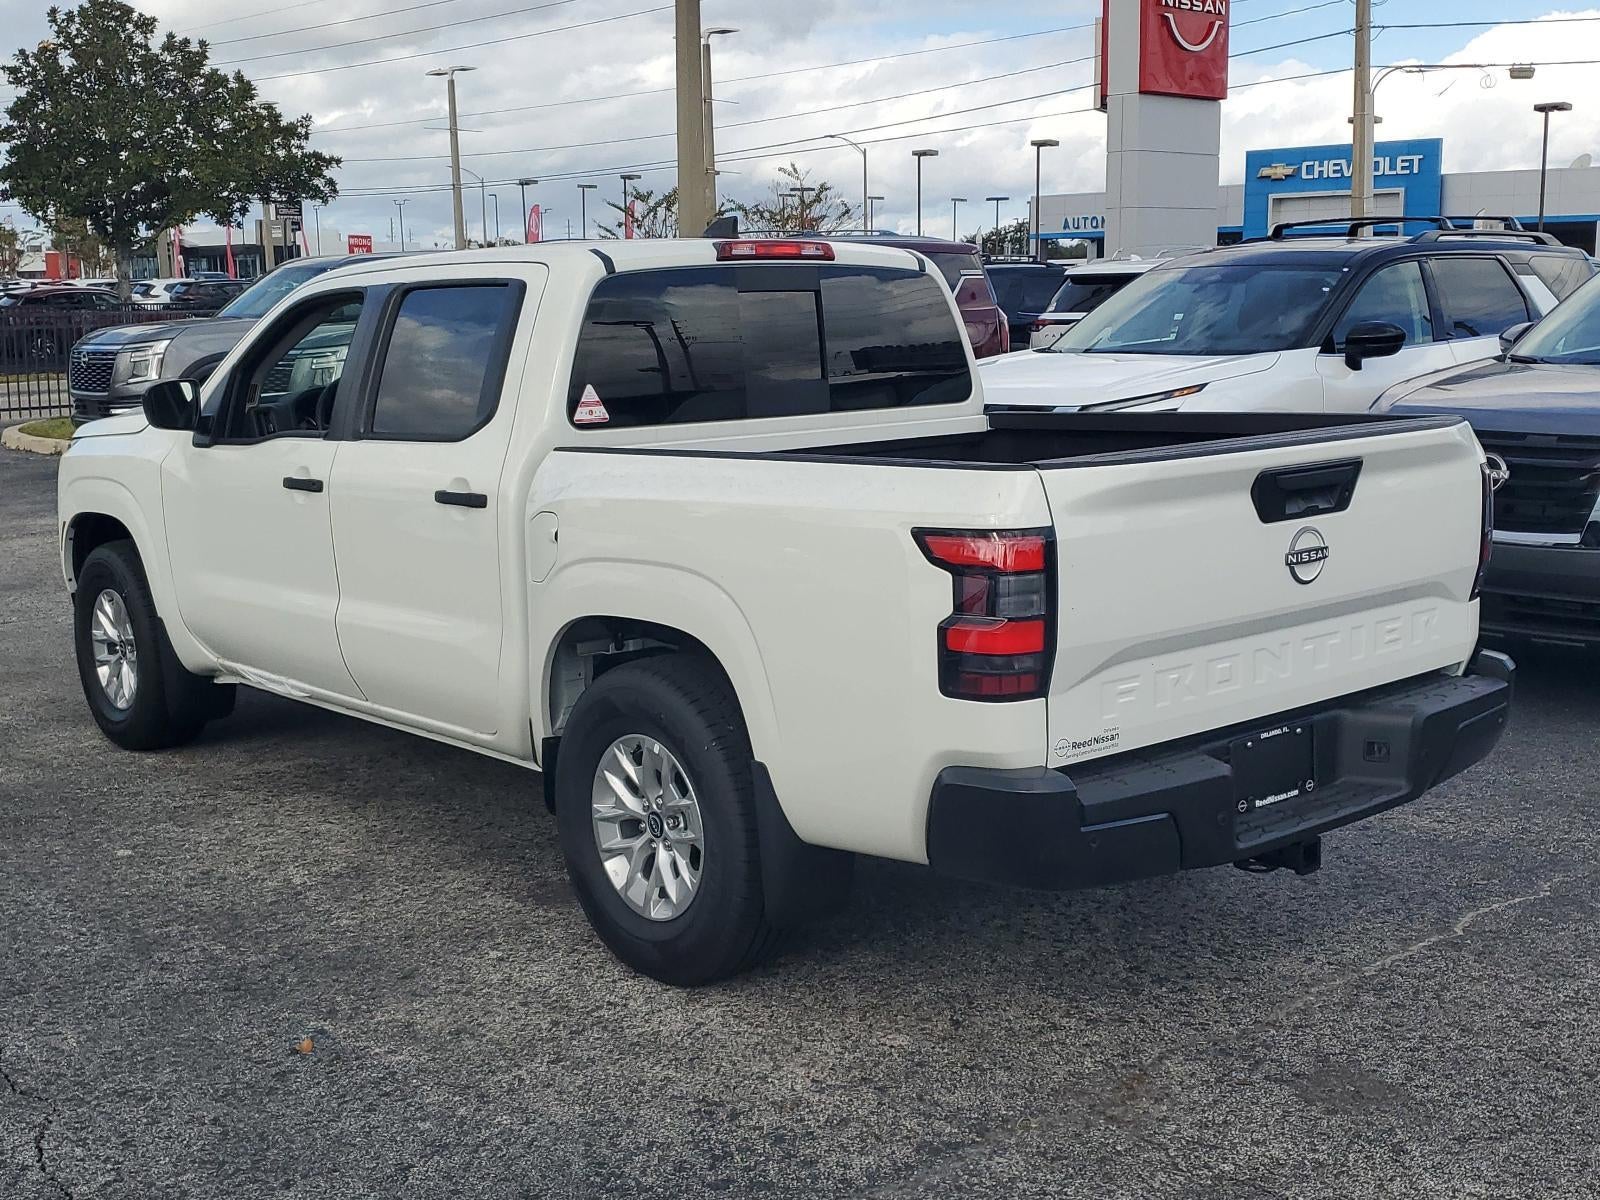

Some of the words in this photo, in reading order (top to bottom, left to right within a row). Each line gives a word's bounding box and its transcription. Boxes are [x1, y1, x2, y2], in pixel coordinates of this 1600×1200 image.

[1301, 155, 1424, 180] CHEVOLET
[349, 237, 372, 246] WRONG
[353, 246, 368, 255] WAY
[1288, 548, 1329, 564] NISSAN
[1101, 606, 1441, 720] FRONTIER
[1255, 789, 1299, 808] ReedNissan.com
